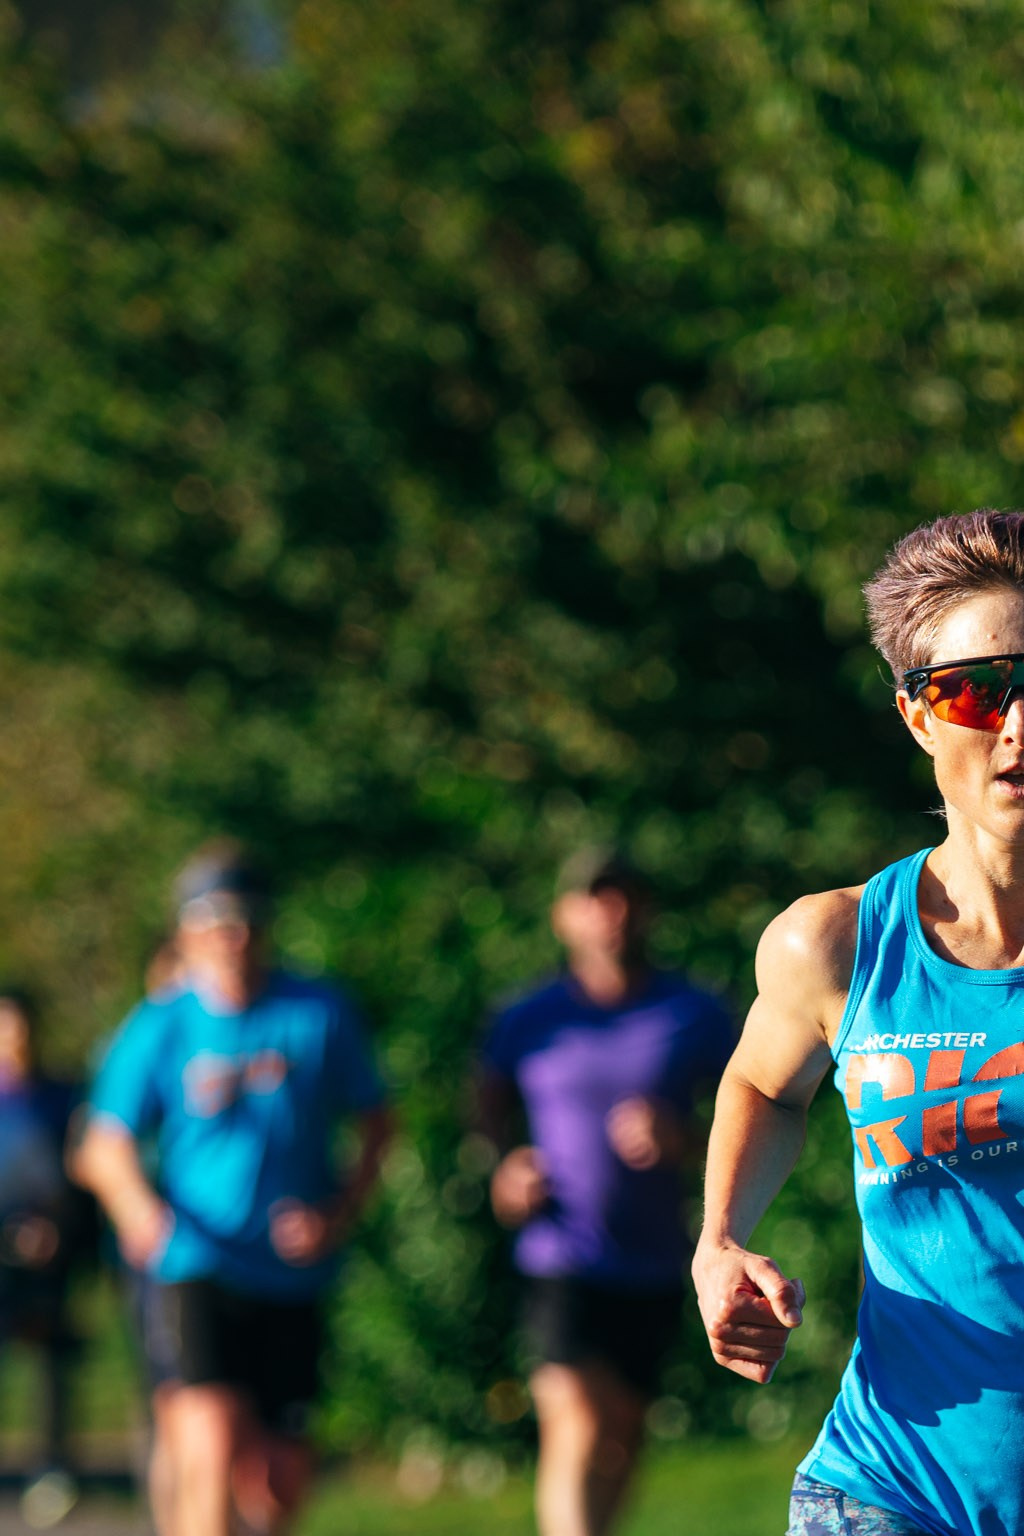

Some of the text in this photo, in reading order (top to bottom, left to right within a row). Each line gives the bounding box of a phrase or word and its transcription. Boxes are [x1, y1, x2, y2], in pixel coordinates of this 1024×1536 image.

[850, 1032, 987, 1051] RCHESTER
[937, 1154, 959, 1168] IS
[971, 1141, 1018, 1161] OUR
